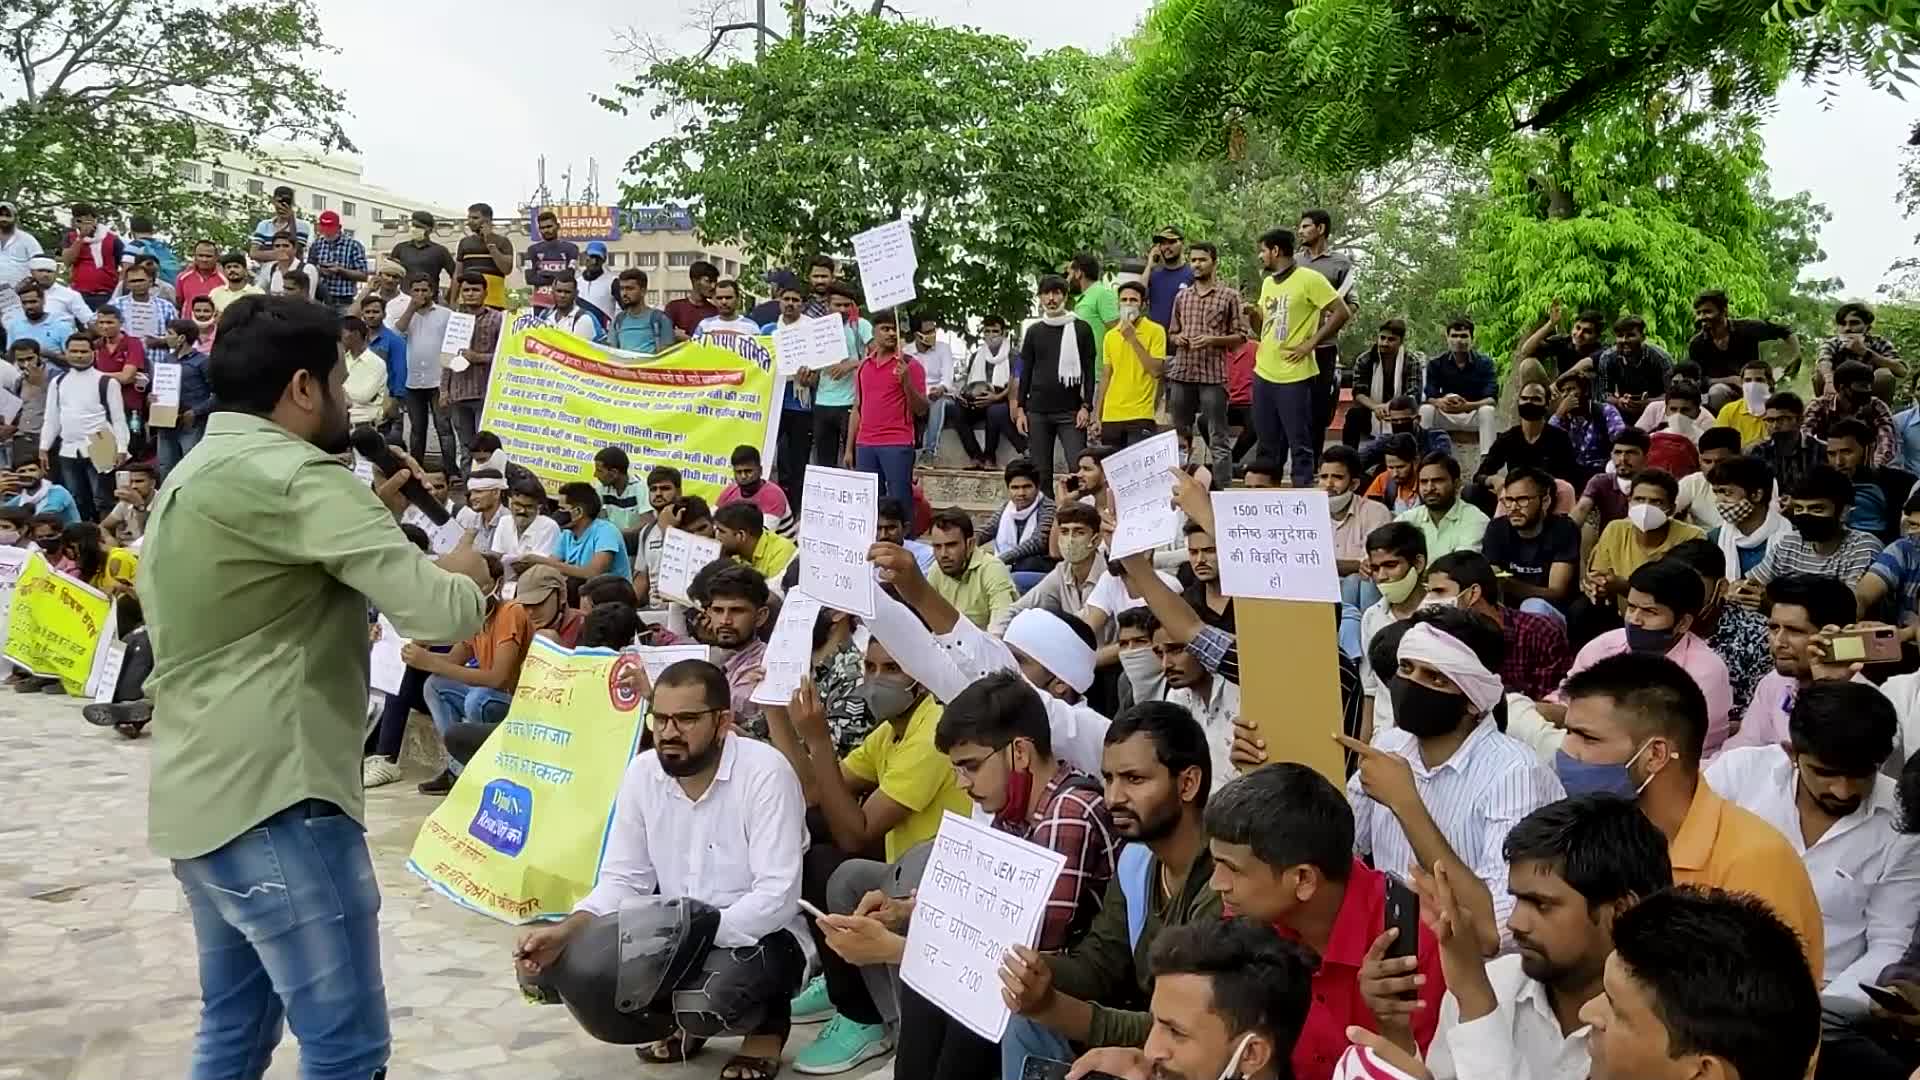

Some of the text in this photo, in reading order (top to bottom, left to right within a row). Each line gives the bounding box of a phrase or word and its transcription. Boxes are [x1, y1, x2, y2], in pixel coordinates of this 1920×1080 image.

[557, 217, 612, 228] ANERVALA
[837, 490, 853, 504] JEN
[1233, 504, 1258, 516] 1500
[1291, 500, 1307, 516] की
[1227, 524, 1318, 545] कनिष्ठ अनुदेशक
[1229, 547, 1320, 565] की विज्ञप्ति जारी
[1270, 572, 1281, 588] हो
[994, 862, 1017, 883] JEN
[1000, 896, 1024, 926] करो
[958, 966, 982, 993] 2100
